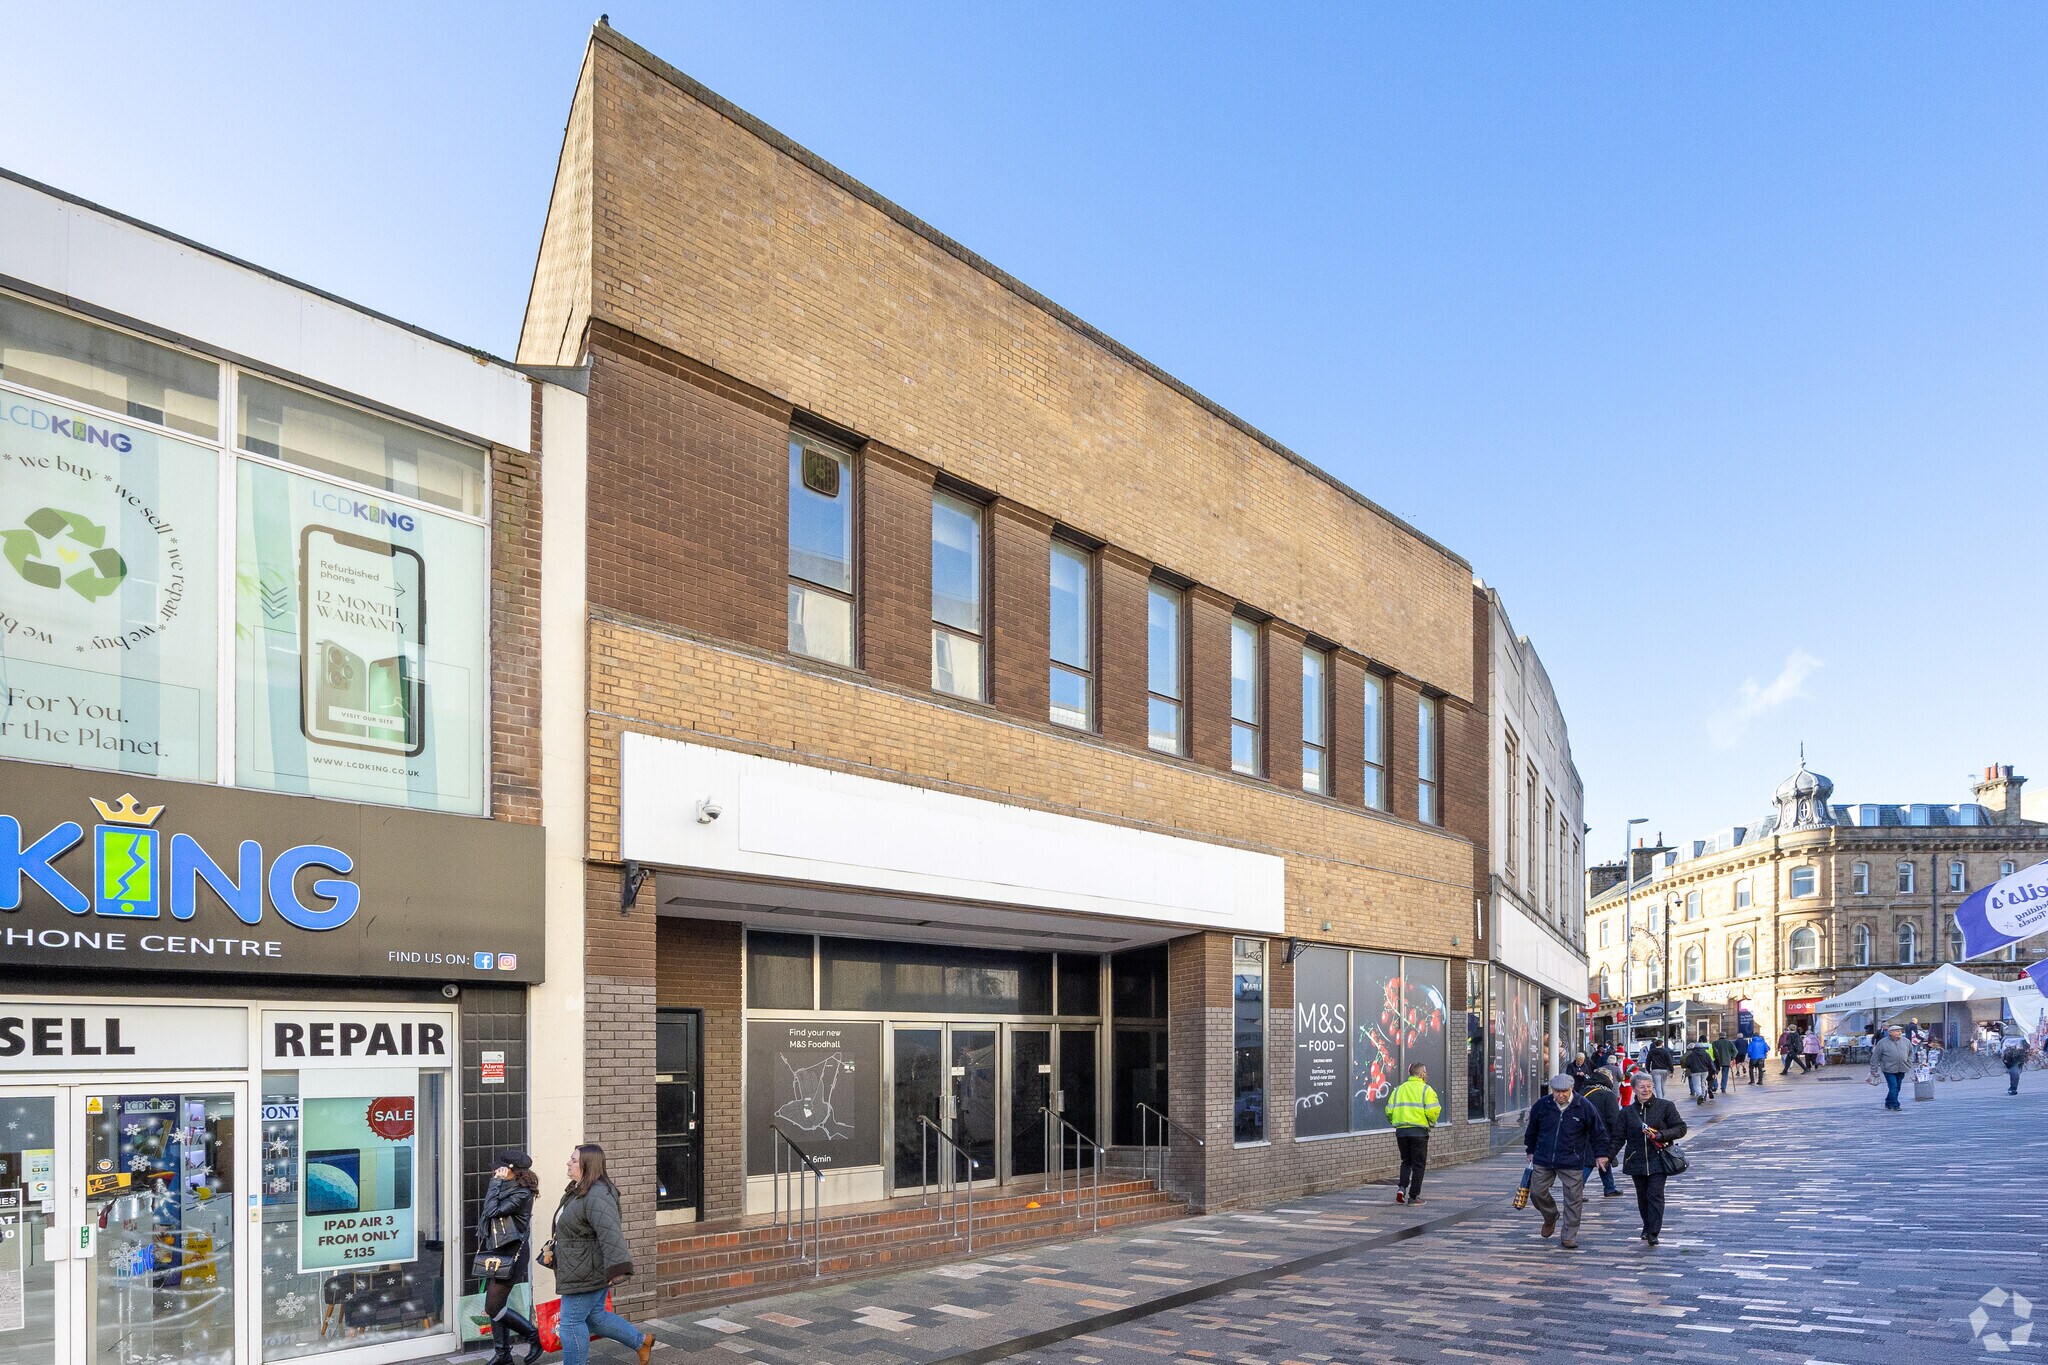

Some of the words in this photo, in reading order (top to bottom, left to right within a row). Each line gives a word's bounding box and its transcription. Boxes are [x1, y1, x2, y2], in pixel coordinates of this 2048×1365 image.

[18, 455, 50, 468] we
[57, 455, 98, 482] buy
[115, 484, 141, 507] we
[140, 507, 173, 535] sell
[168, 548, 184, 571] we
[320, 560, 380, 581] Refurbished
[320, 571, 356, 585] phones
[160, 574, 185, 622] repair
[316, 589, 331, 604] 12
[338, 593, 399, 619] MONTH
[316, 605, 408, 634] WARRANTY
[90, 635, 131, 650] buy
[129, 625, 156, 642] we
[8, 687, 60, 712] For
[67, 695, 129, 723] You.
[341, 711, 361, 720] VISIT
[362, 715, 377, 723] OUR
[23, 719, 70, 744] the
[78, 728, 169, 757] Planet.
[312, 756, 420, 777] WWW.LCDKING.CO.UK
[0, 815, 361, 931] KING
[0, 927, 127, 950] HONE
[140, 934, 283, 958] CENTRE
[388, 951, 421, 963] FIND
[424, 952, 442, 964] US
[445, 954, 470, 965] ON:
[1888, 995, 1910, 1003] BARNSLEY
[1910, 993, 1931, 1001] MARKETS
[1298, 1002, 1346, 1034] M&S
[0, 1016, 136, 1057] SELL
[274, 1022, 446, 1057] REPAIR
[789, 1028, 807, 1036] Find
[808, 1029, 825, 1037] your
[789, 1040, 807, 1048] M&S
[808, 1040, 841, 1048] Foodhall
[1308, 1040, 1336, 1051] FOOD
[374, 1110, 413, 1122] SALE
[812, 1155, 832, 1163] 6min
[324, 1219, 356, 1231] IPAD
[359, 1216, 382, 1227] AIR
[385, 1215, 394, 1225] 3
[318, 1233, 358, 1246] FROM
[361, 1229, 399, 1242] ONLY
[344, 1246, 375, 1259] £135
